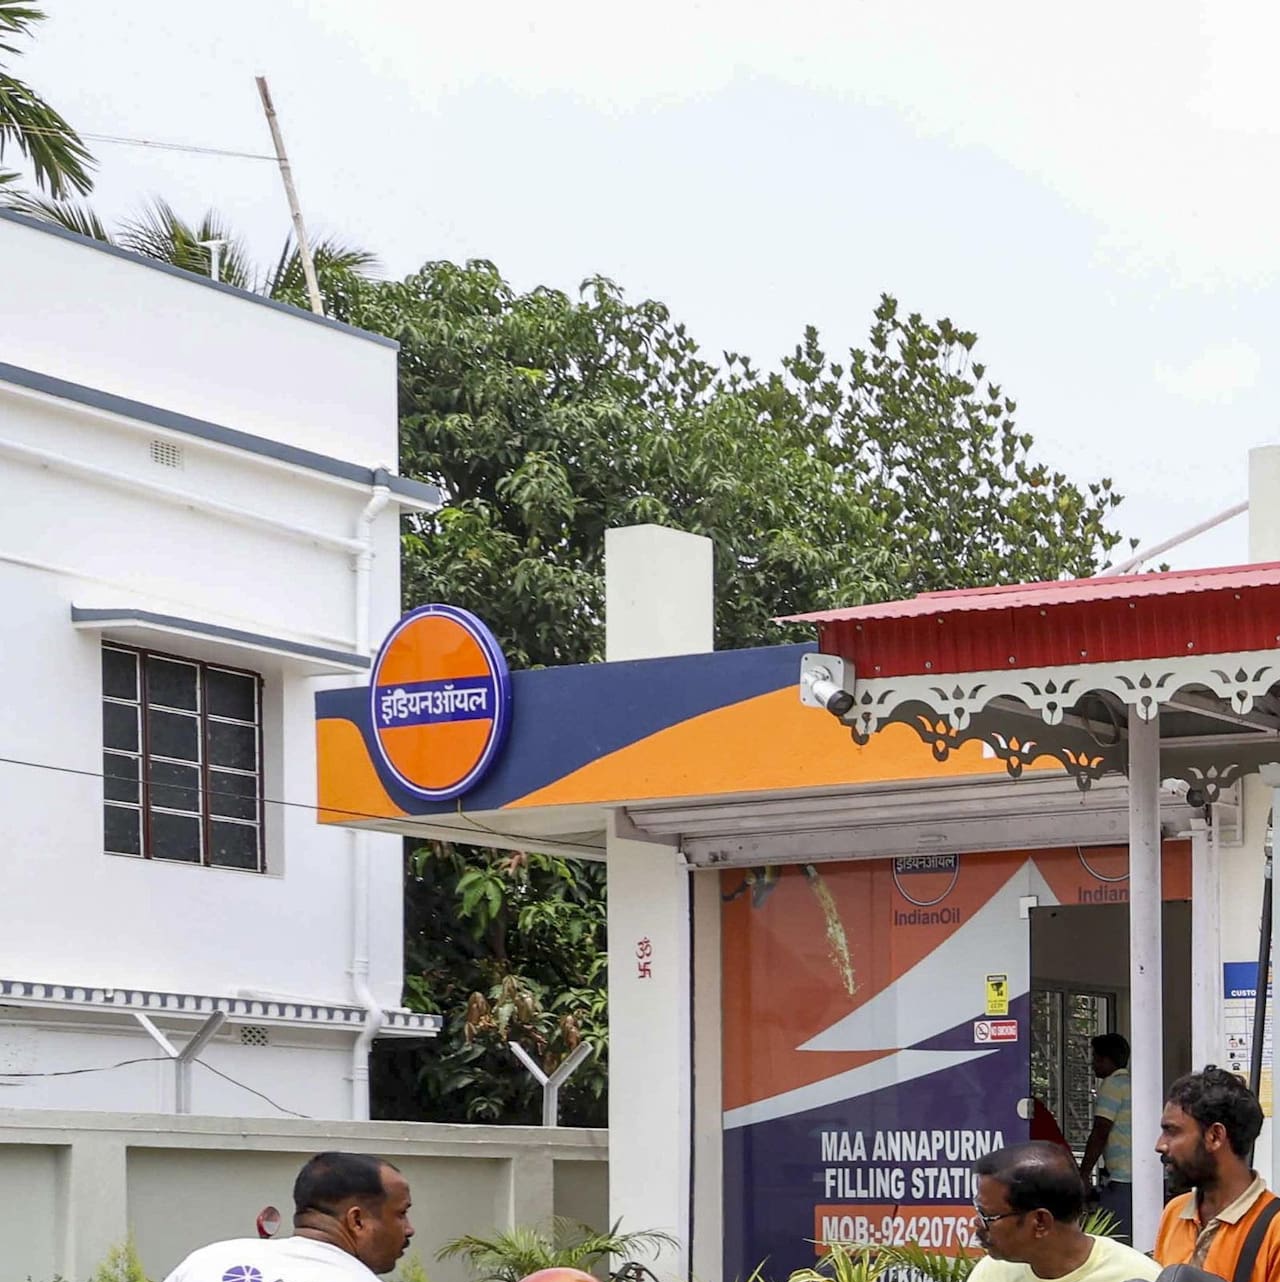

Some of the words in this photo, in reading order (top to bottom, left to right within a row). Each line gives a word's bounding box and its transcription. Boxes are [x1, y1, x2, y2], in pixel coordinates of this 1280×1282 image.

[382, 685, 488, 724] इंडियनऑयल
[894, 908, 960, 925] IndianOil
[821, 1131, 867, 1162] MAA
[825, 1168, 905, 1199] FILLING
